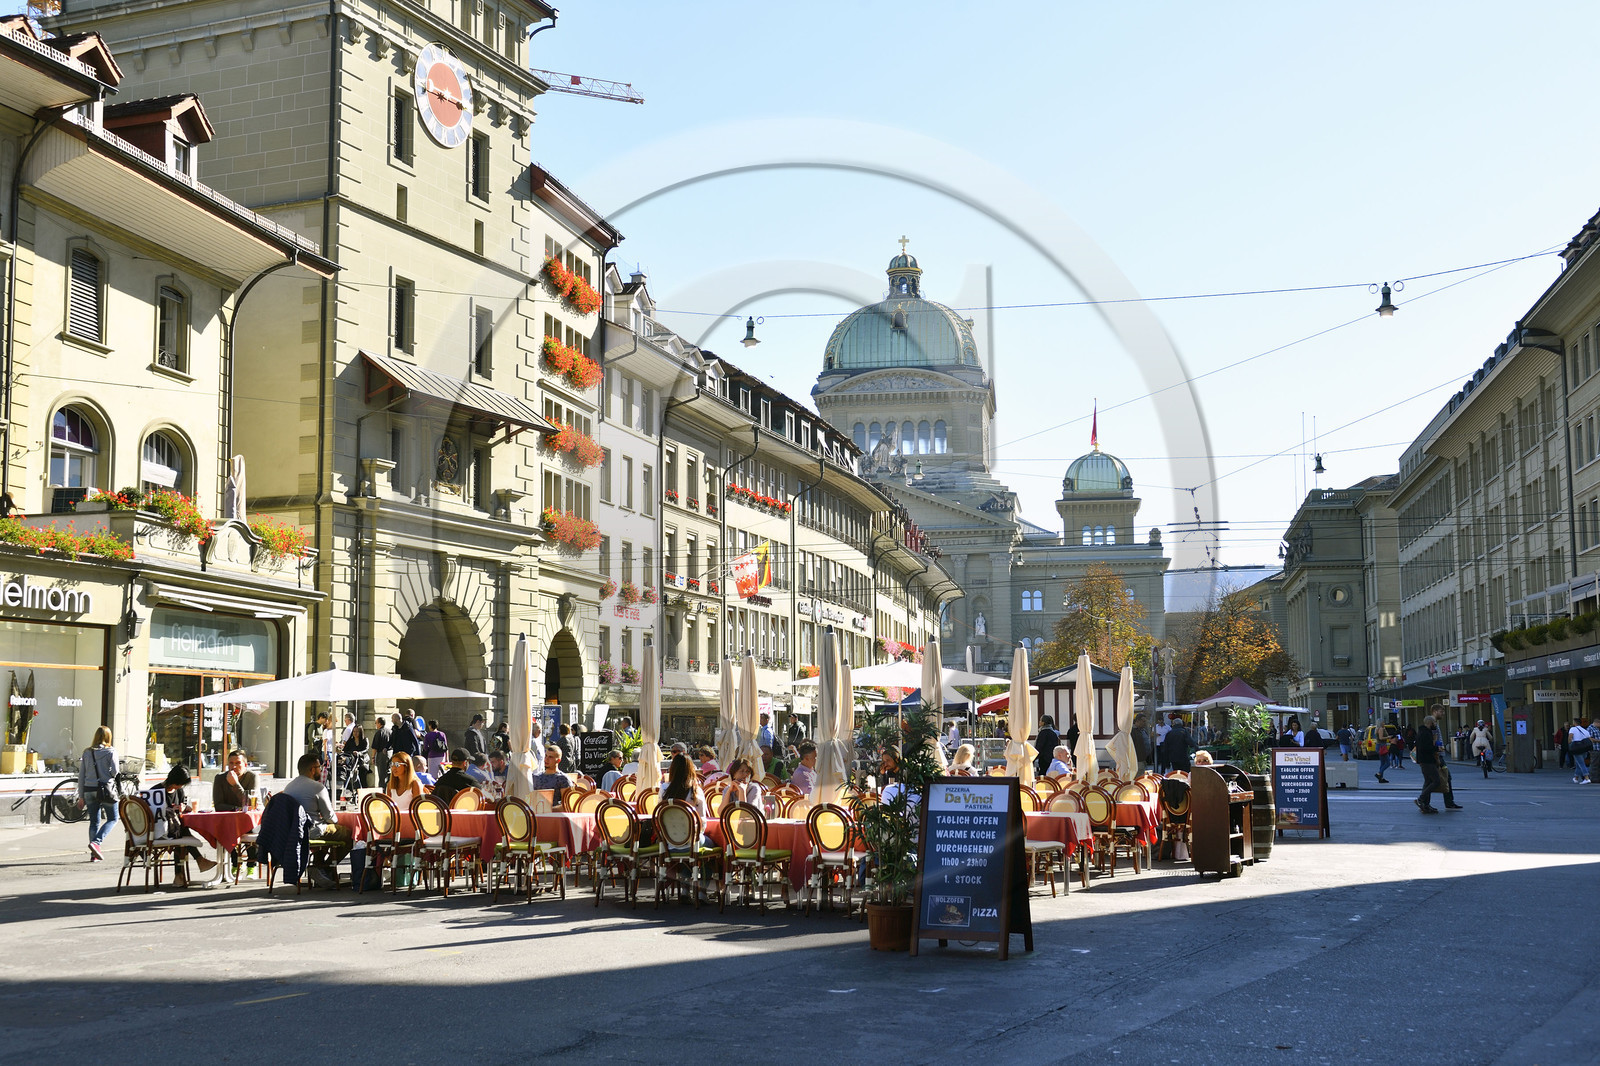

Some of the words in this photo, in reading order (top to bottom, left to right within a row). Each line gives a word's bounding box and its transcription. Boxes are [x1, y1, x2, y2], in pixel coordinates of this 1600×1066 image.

[171, 622, 233, 656] fielmann
[116, 673, 121, 683] 3
[945, 793, 961, 803] Da
[963, 794, 993, 804] Vinci
[936, 816, 970, 824] TÄGLICH
[973, 816, 999, 825] OFFEN
[936, 830, 967, 838] WARME
[936, 844, 994, 854] DURCHGEHEND
[942, 858, 959, 866] 11h00
[966, 858, 988, 867] 23h00
[944, 875, 949, 883] 1.
[955, 876, 982, 884] STOCK
[972, 908, 998, 917] PIZZA
